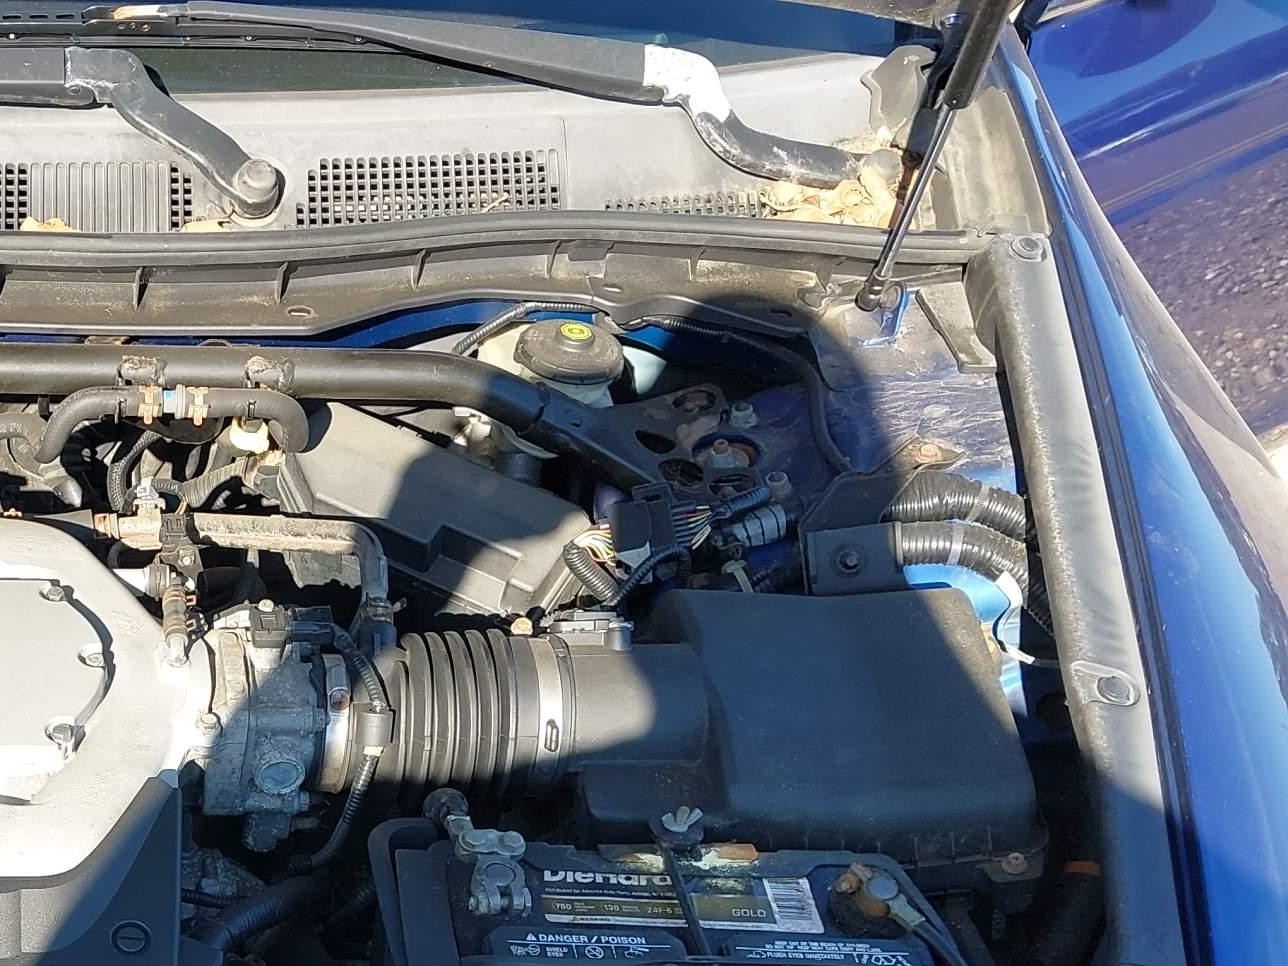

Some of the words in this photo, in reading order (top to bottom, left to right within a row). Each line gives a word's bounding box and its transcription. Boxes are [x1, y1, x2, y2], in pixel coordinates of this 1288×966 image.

[731, 908, 767, 917] GOLD
[538, 933, 589, 943] DANGER
[601, 935, 647, 945] POISON
